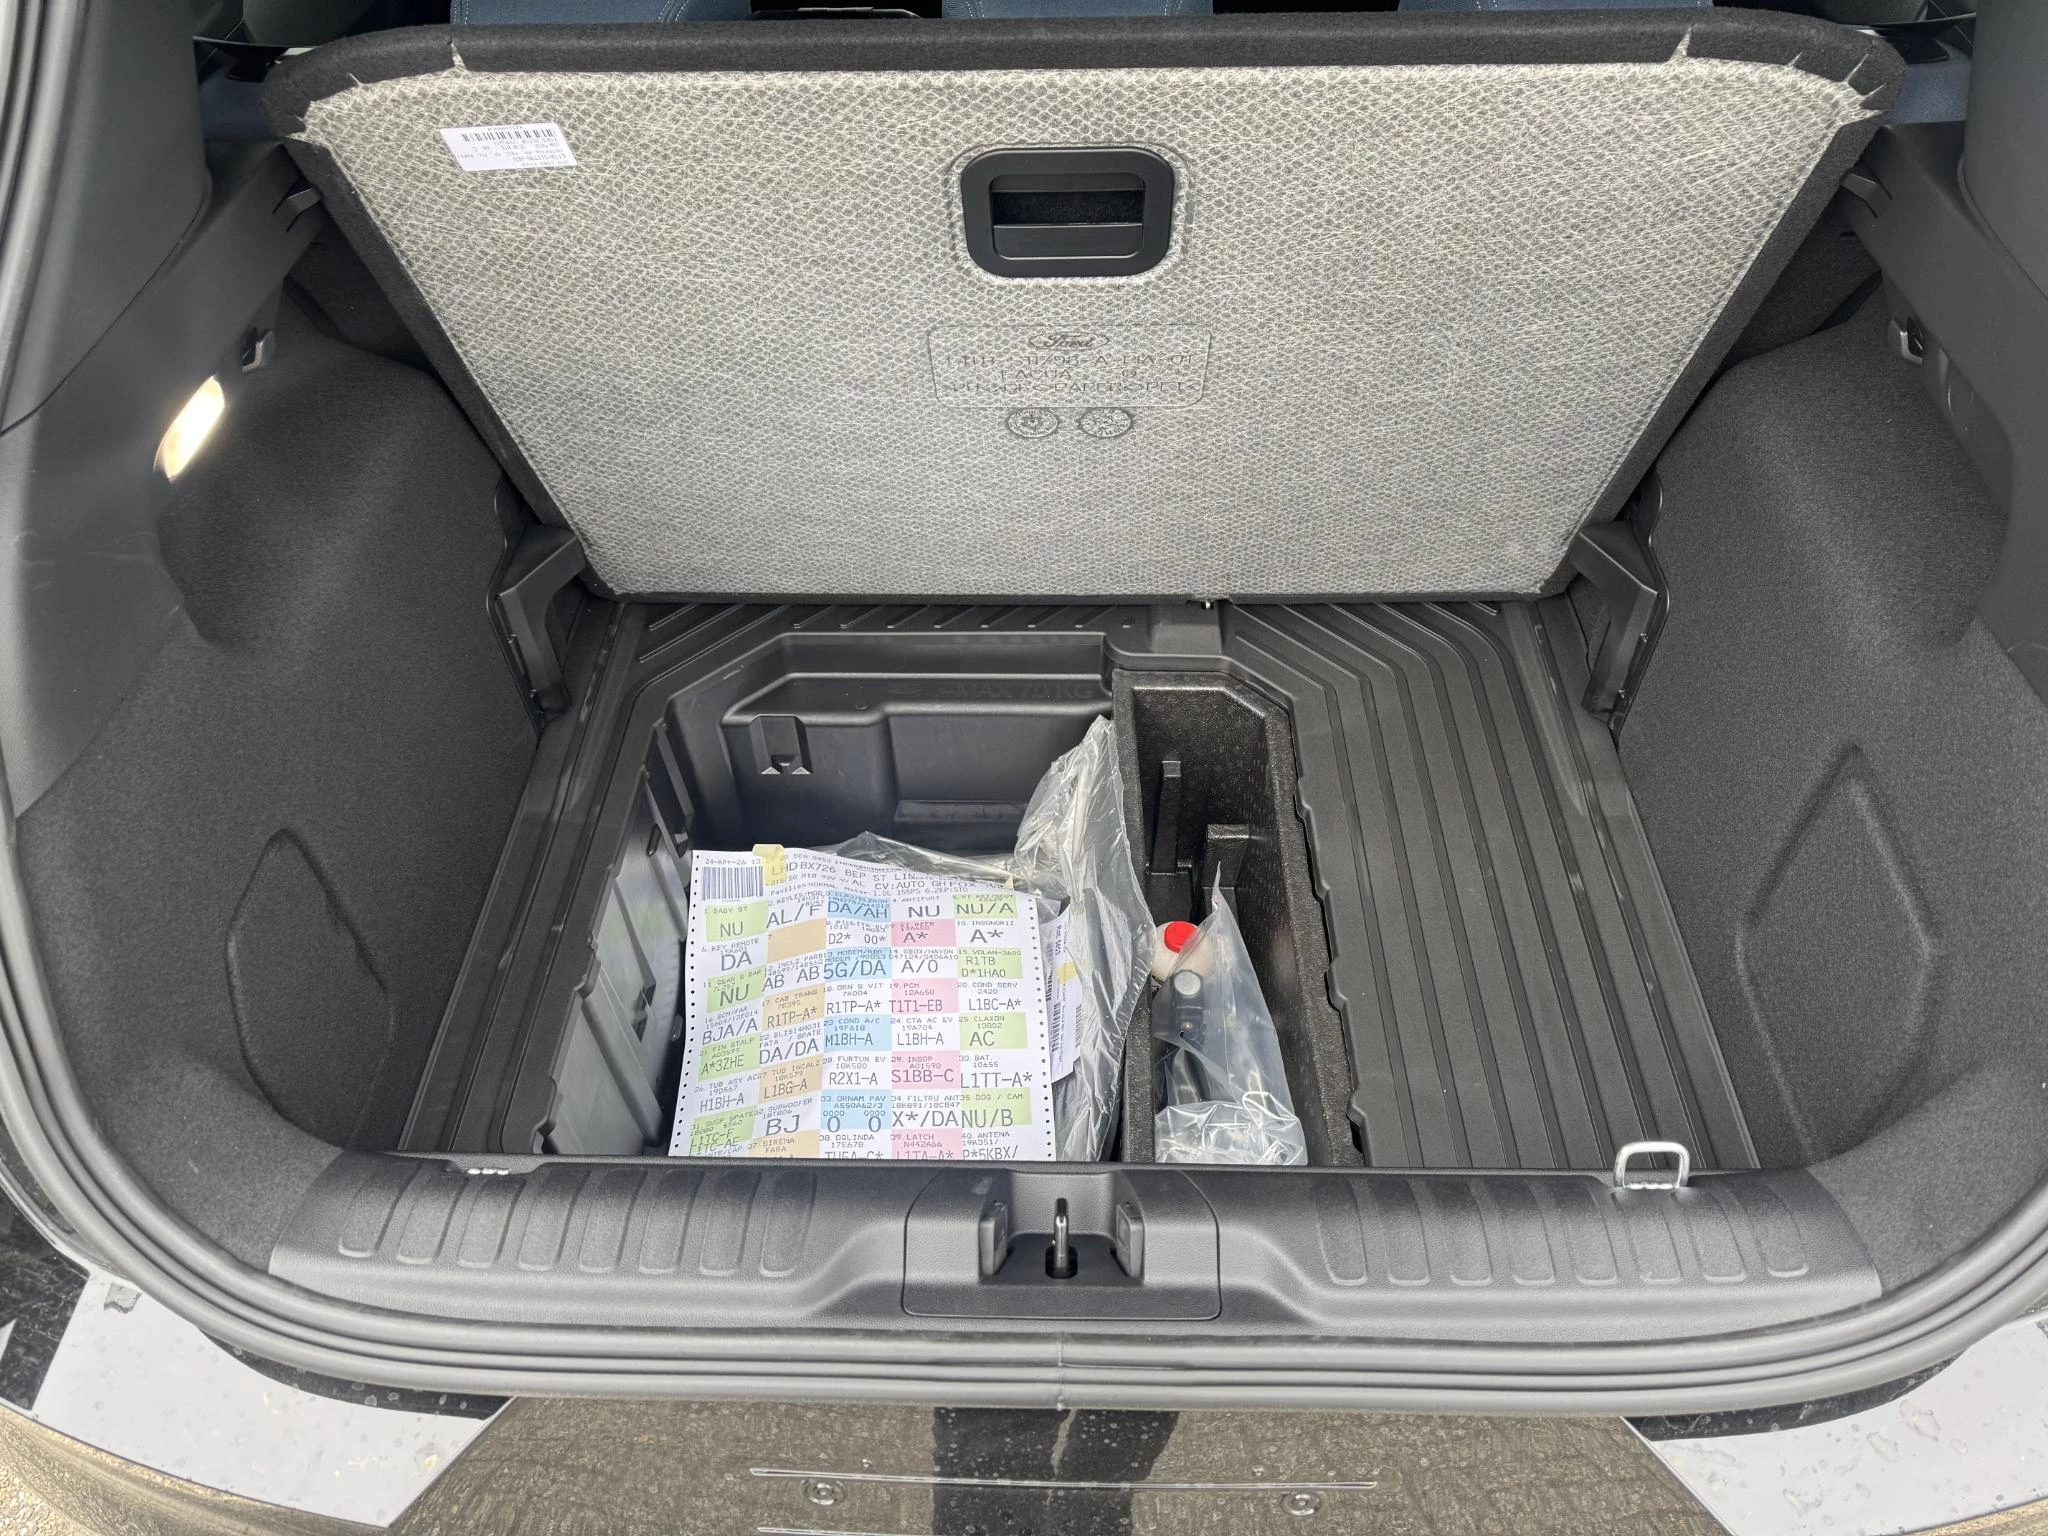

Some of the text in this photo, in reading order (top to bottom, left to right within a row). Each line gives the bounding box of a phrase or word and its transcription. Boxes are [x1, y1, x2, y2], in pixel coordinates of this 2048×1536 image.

[1042, 334, 1095, 348] Ford
[957, 683, 1014, 699] MAX
[1055, 683, 1093, 699] KG
[800, 861, 836, 873] BX726
[844, 869, 866, 879] BEP
[873, 874, 888, 882] ST
[766, 903, 823, 929] AL/F
[827, 901, 888, 919] DA/AH
[908, 905, 940, 918] NU
[956, 902, 1014, 915] NU/A
[720, 921, 744, 938] NU
[711, 944, 727, 952] KEY
[731, 937, 760, 949] REMOTE
[721, 951, 753, 971] DA
[966, 957, 996, 966] R1TB
[823, 960, 887, 980] 5G/DA
[762, 973, 785, 993] AB
[797, 965, 820, 984] AB
[720, 983, 750, 1007] NU
[775, 996, 789, 1004] CAB
[888, 999, 943, 1013] T1T1-EB
[702, 1017, 759, 1046] BJA/A
[897, 1032, 944, 1046] L1BH-A
[969, 1030, 995, 1047] AC
[825, 1032, 874, 1048] M1BH-A
[760, 1038, 820, 1065] DA/DA
[829, 1072, 878, 1086] R2X1-A
[891, 1068, 955, 1083] S1BB-C
[763, 1078, 808, 1100] L1BG-A
[1007, 1092, 1024, 1100] CAM
[700, 1091, 744, 1113] H1BH-A
[765, 1114, 800, 1137] BJ
[961, 1108, 1014, 1128] NU/B
[905, 1133, 935, 1141] LATCH
[977, 1130, 1010, 1138] ANTENA
[765, 1146, 787, 1154] FARA
